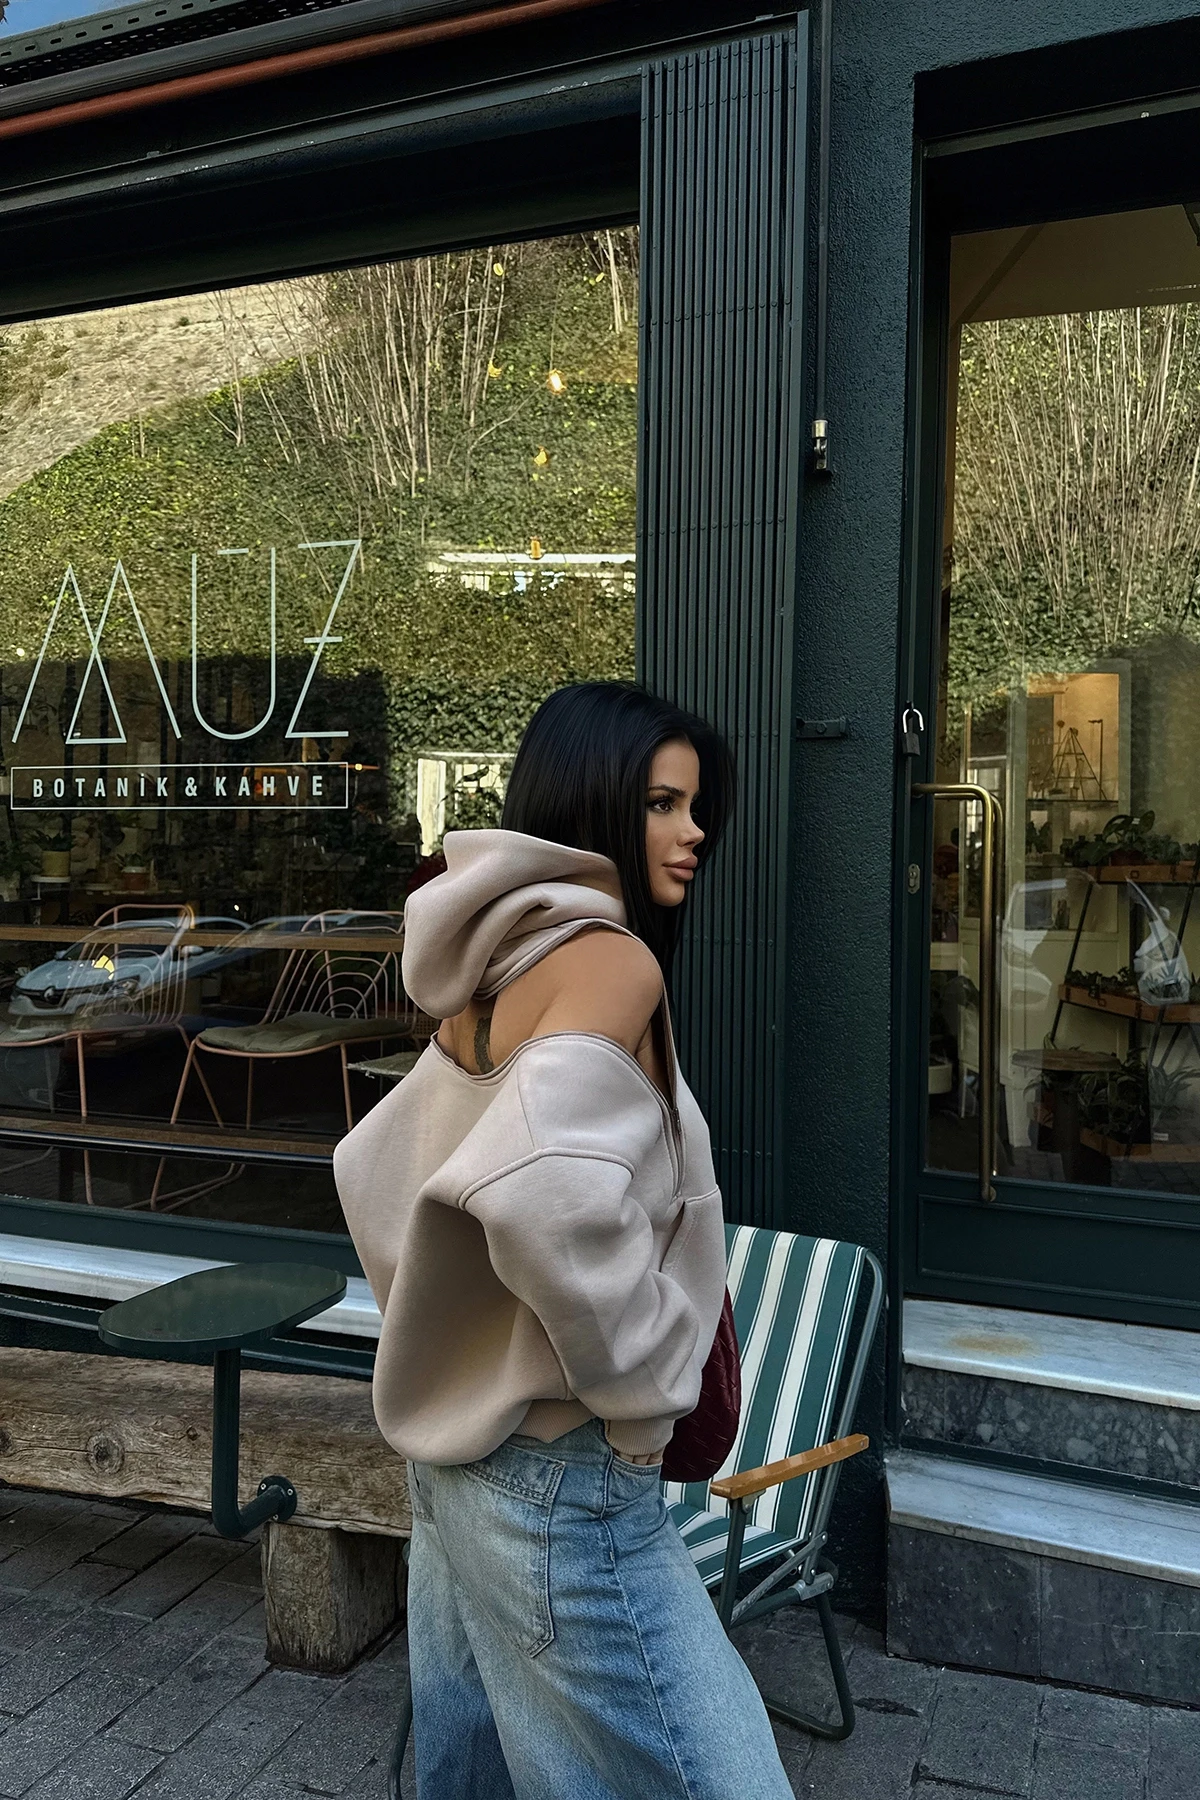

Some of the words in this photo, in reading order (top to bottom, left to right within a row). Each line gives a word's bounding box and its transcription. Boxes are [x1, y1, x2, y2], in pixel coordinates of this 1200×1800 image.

[33, 773, 169, 798] BOTANİK
[185, 778, 198, 797] &
[215, 775, 323, 797] KAHVE
